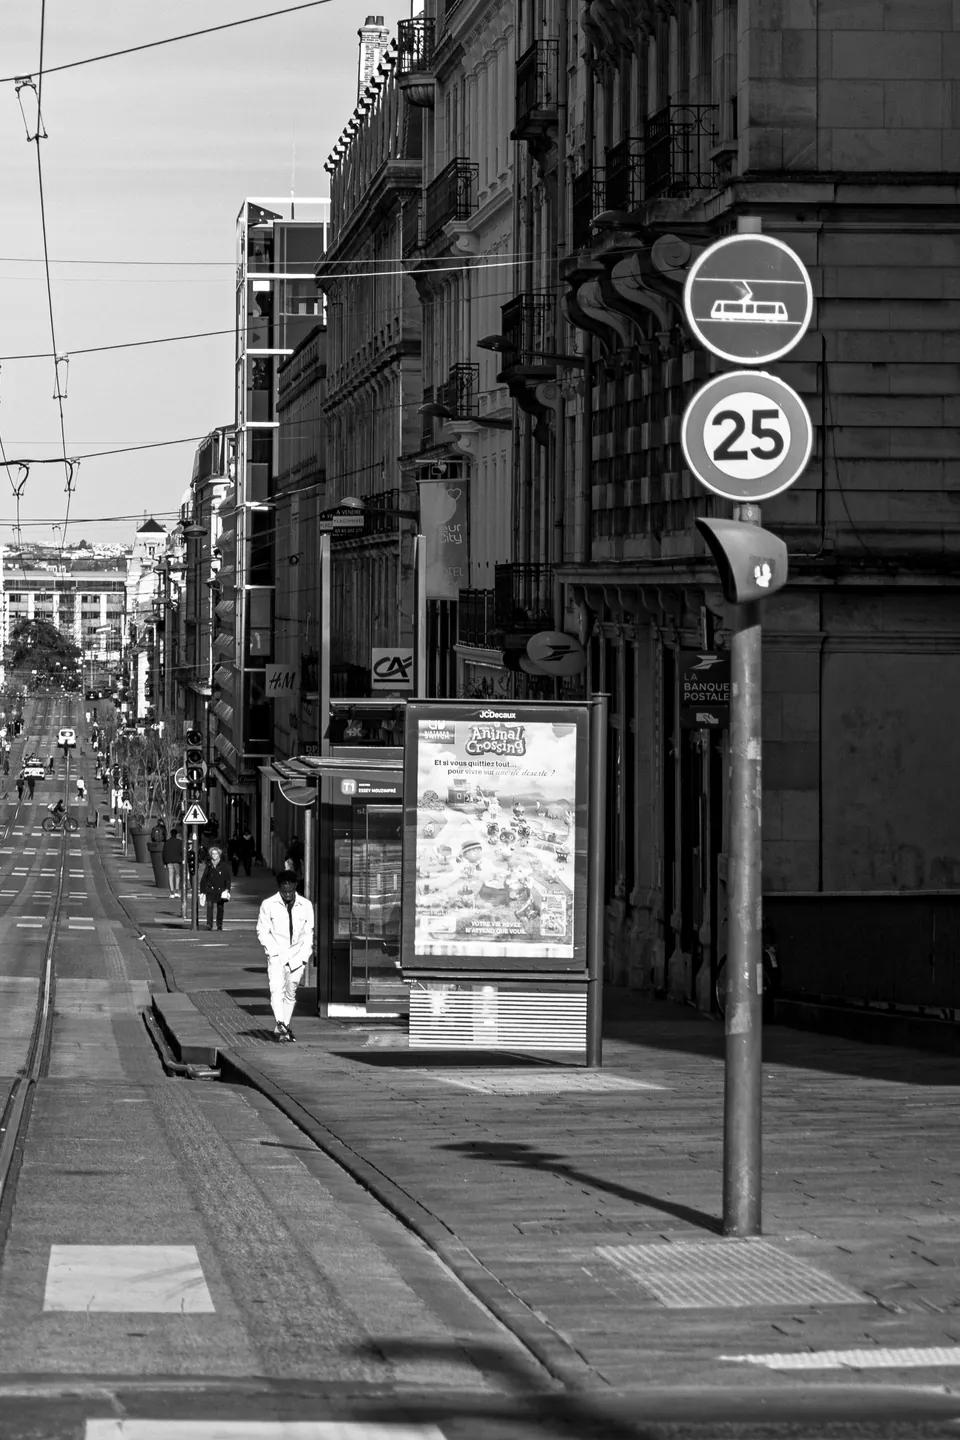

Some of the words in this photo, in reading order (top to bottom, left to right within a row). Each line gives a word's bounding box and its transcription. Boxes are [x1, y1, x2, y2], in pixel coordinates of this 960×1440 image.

[711, 409, 784, 460] 25
[269, 672, 296, 689] H&M
[684, 682, 730, 692] BANQUE
[684, 692, 730, 700] POSTALE
[479, 709, 516, 718] JCDecaux
[471, 726, 521, 741] Animal
[466, 739, 525, 754] Crossing
[343, 782, 355, 792] T1
